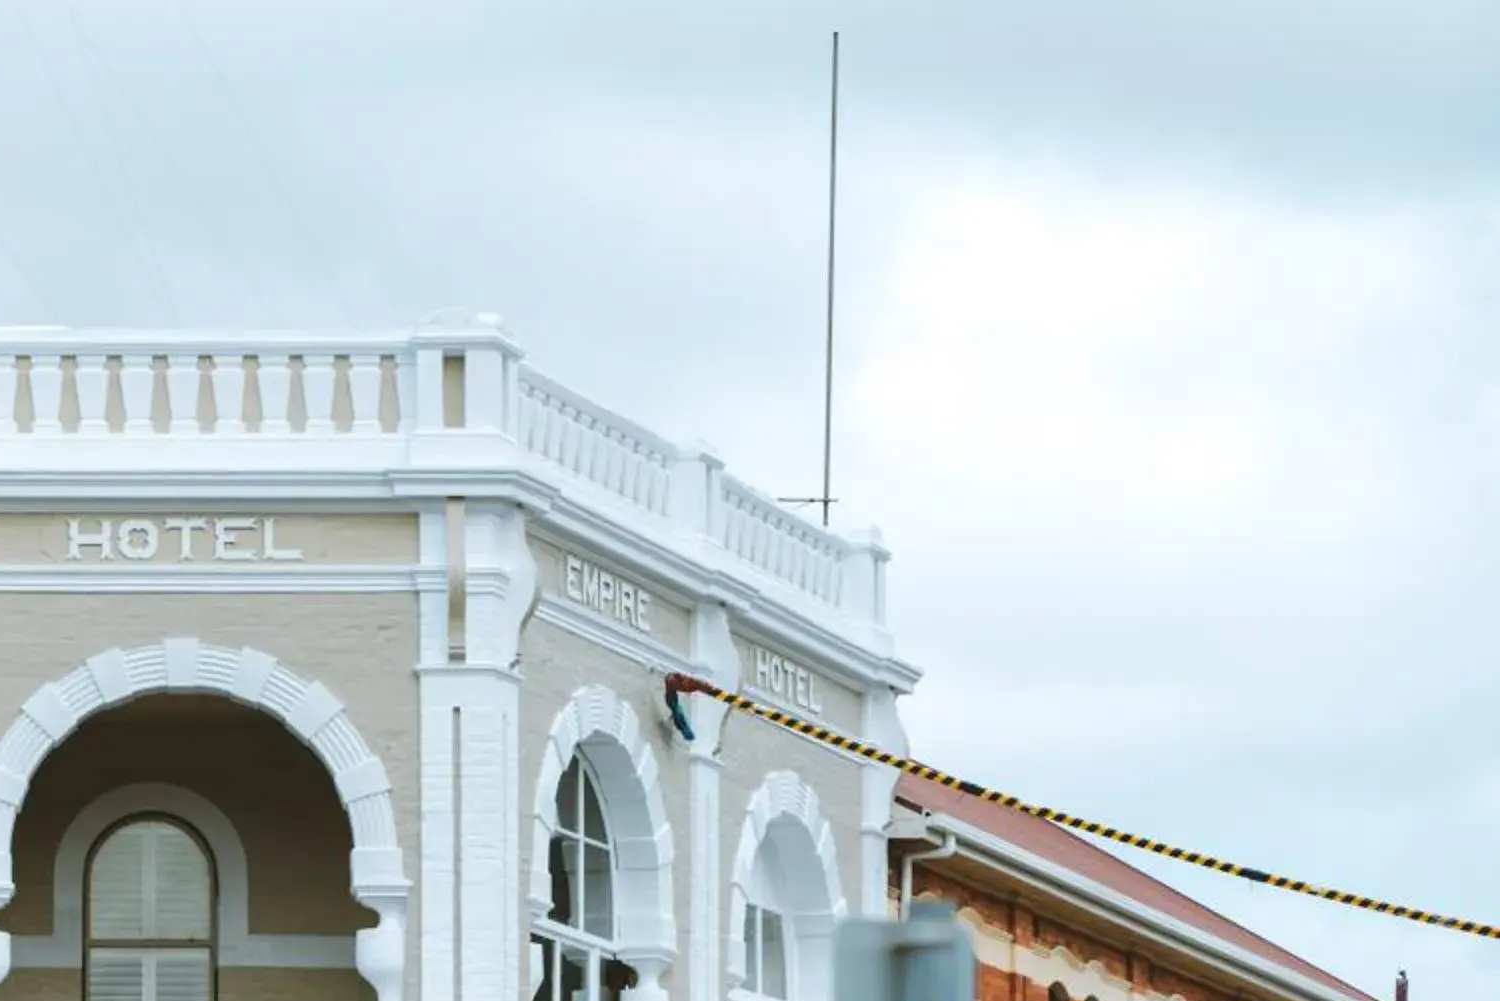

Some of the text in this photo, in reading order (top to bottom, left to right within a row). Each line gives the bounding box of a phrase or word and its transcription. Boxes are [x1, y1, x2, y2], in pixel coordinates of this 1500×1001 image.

[66, 517, 304, 561] HOTEL
[565, 554, 650, 632] EMPIRE
[754, 648, 822, 715] HOTEL
